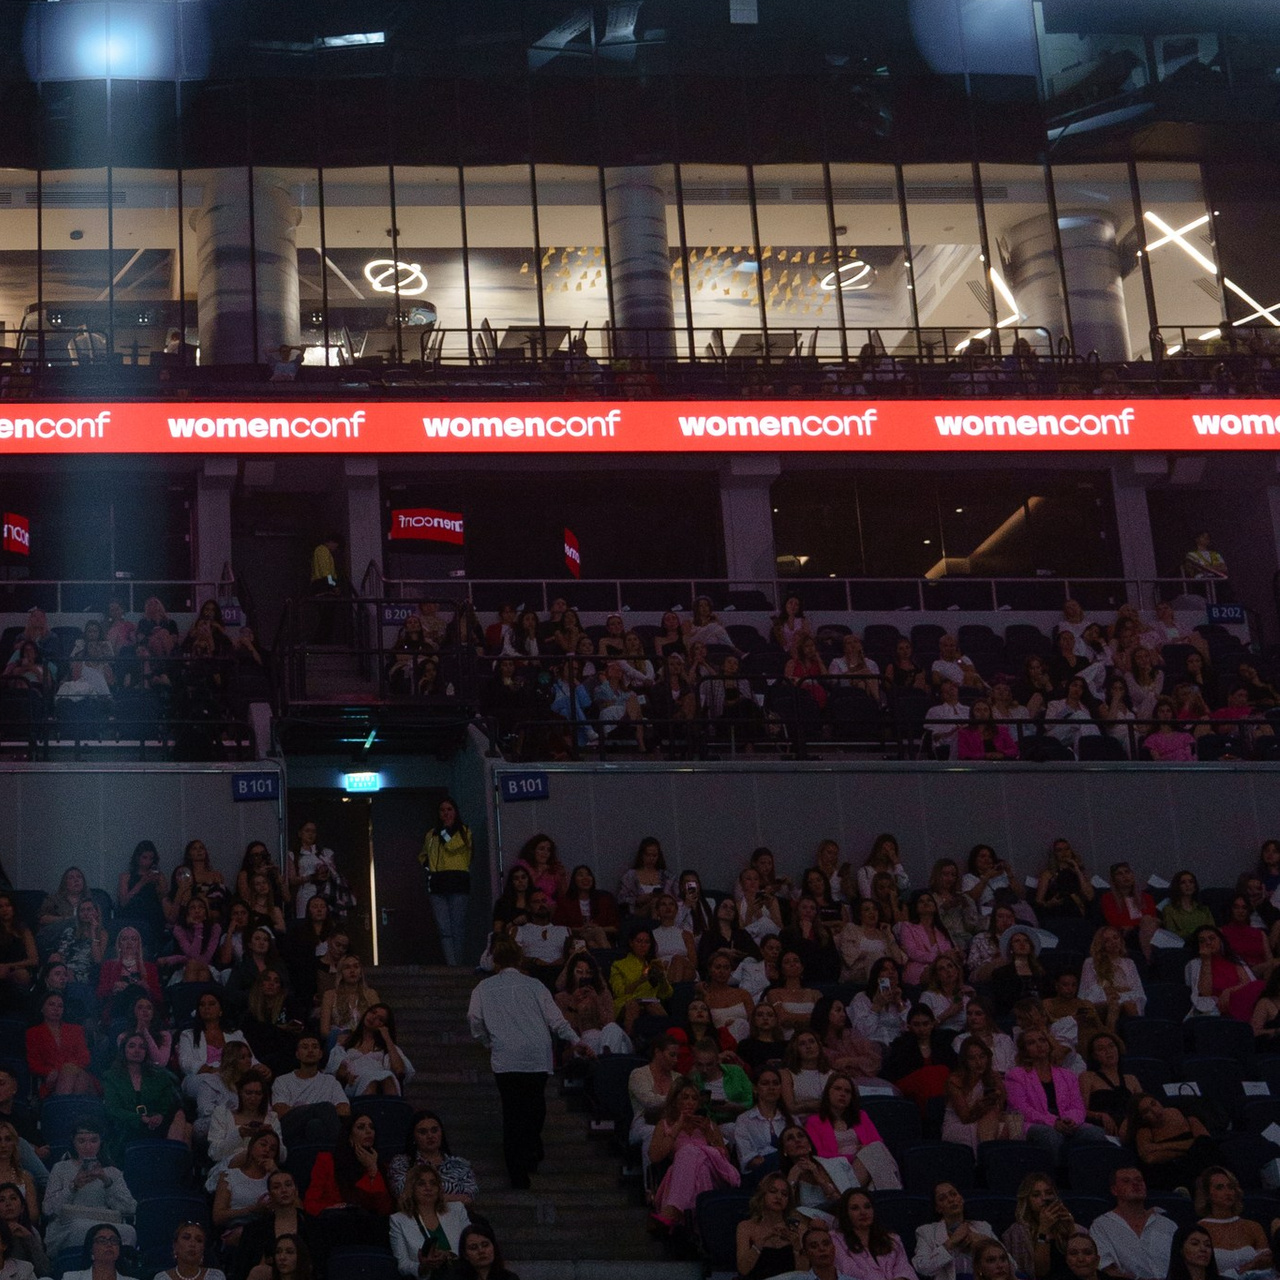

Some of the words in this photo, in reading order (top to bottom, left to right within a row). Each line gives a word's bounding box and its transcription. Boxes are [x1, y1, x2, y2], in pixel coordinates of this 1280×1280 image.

[167, 410, 366, 438] womenconf
[422, 409, 621, 438] womenconf
[678, 408, 878, 437] womenconf
[934, 407, 1135, 436] womenconf
[1192, 414, 1280, 435] wom
